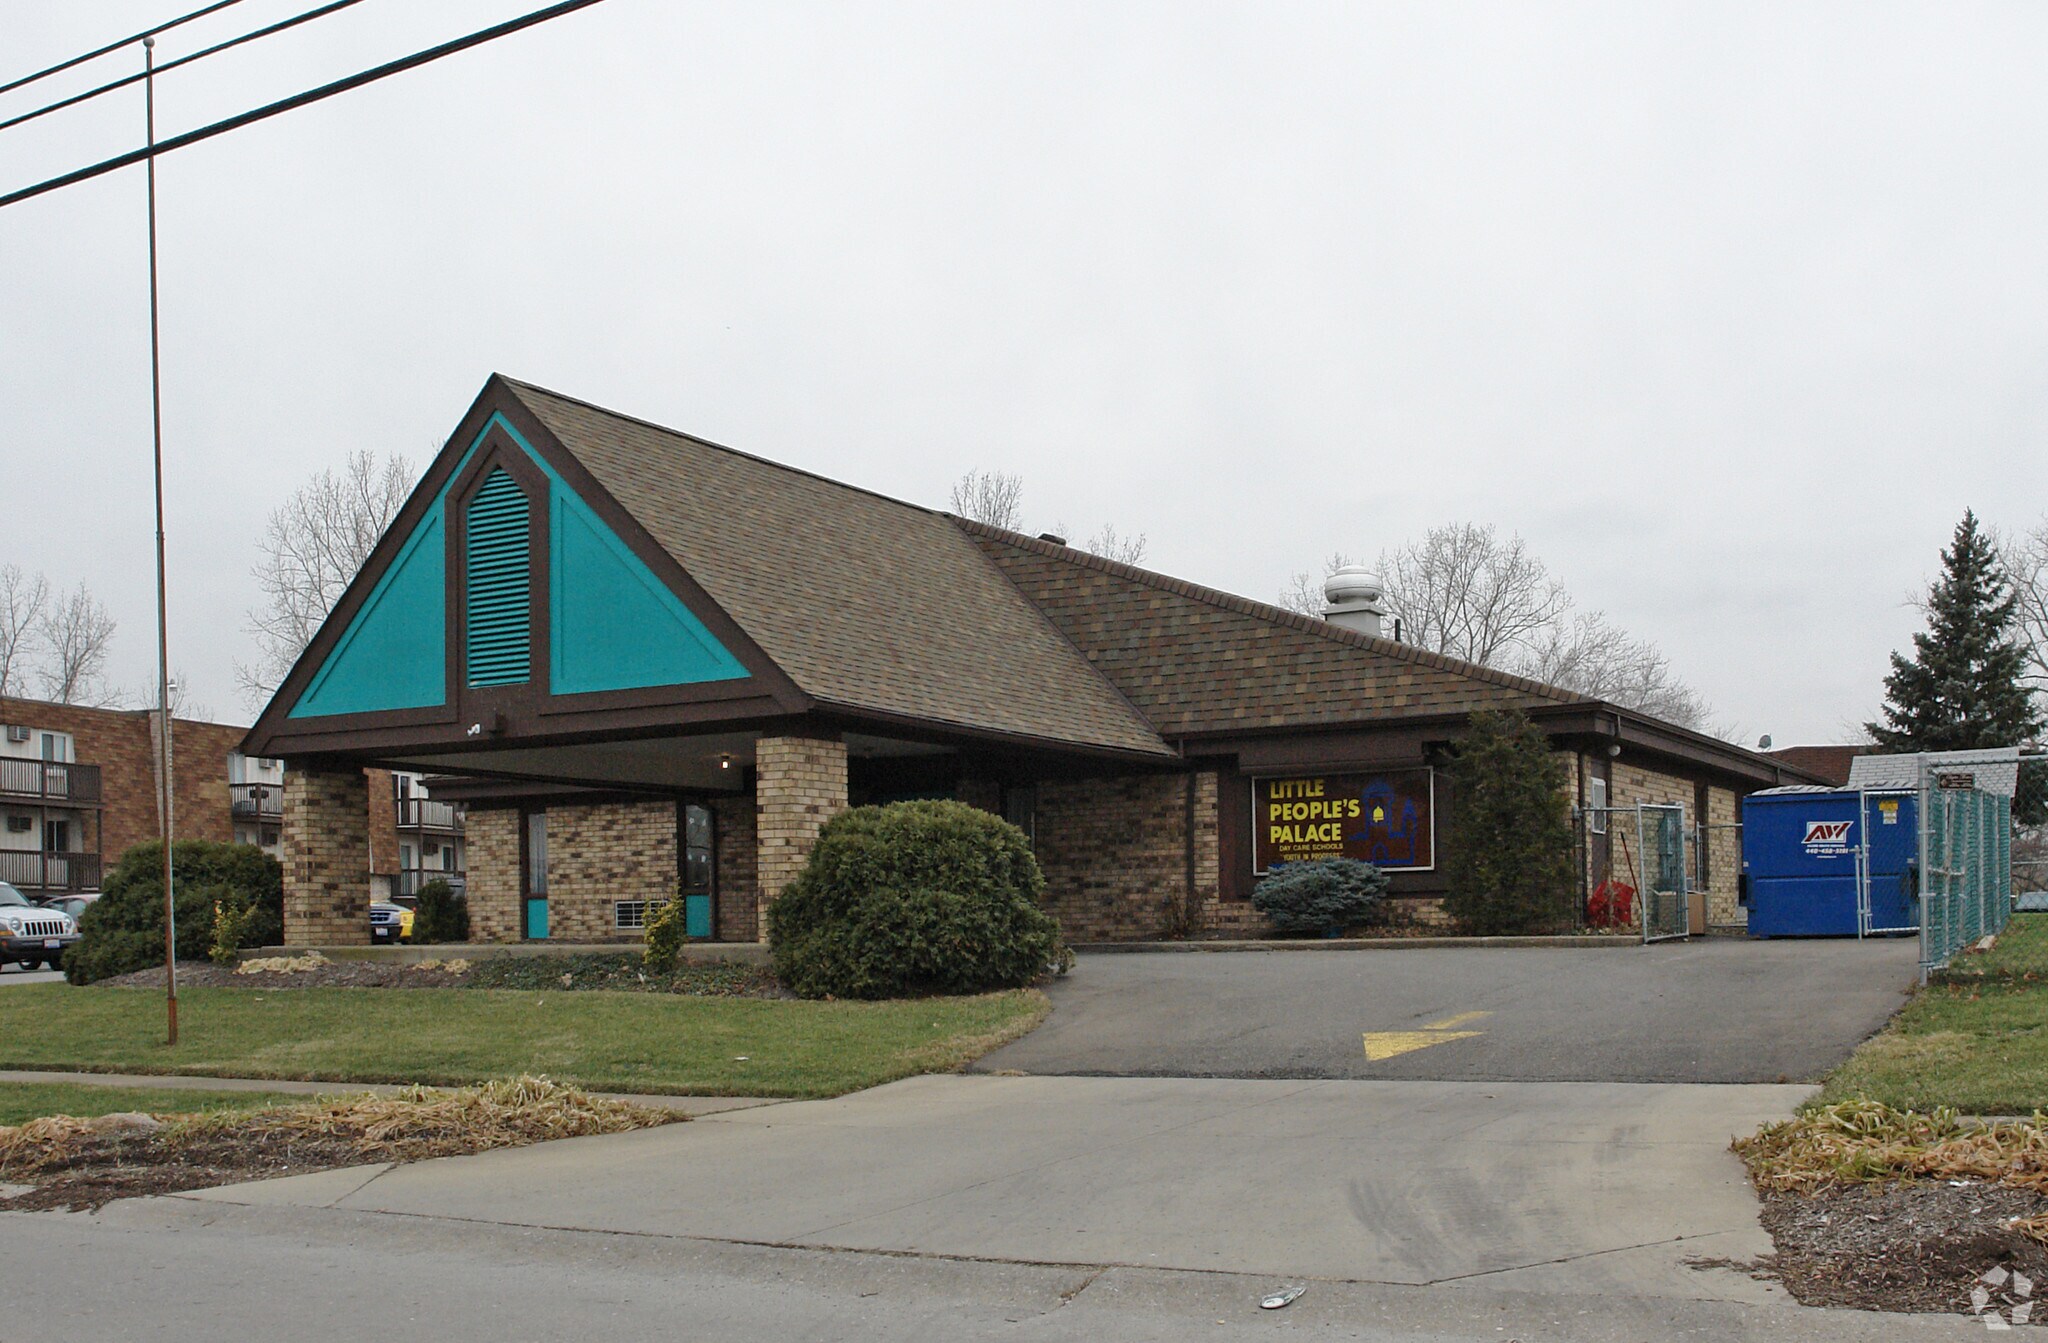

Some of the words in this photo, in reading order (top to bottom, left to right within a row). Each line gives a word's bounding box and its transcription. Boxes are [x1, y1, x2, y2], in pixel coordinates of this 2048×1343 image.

[1270, 779, 1324, 799] LITTLE
[1270, 799, 1361, 821] PEOPLE'S
[1270, 823, 1342, 844] PALACE
